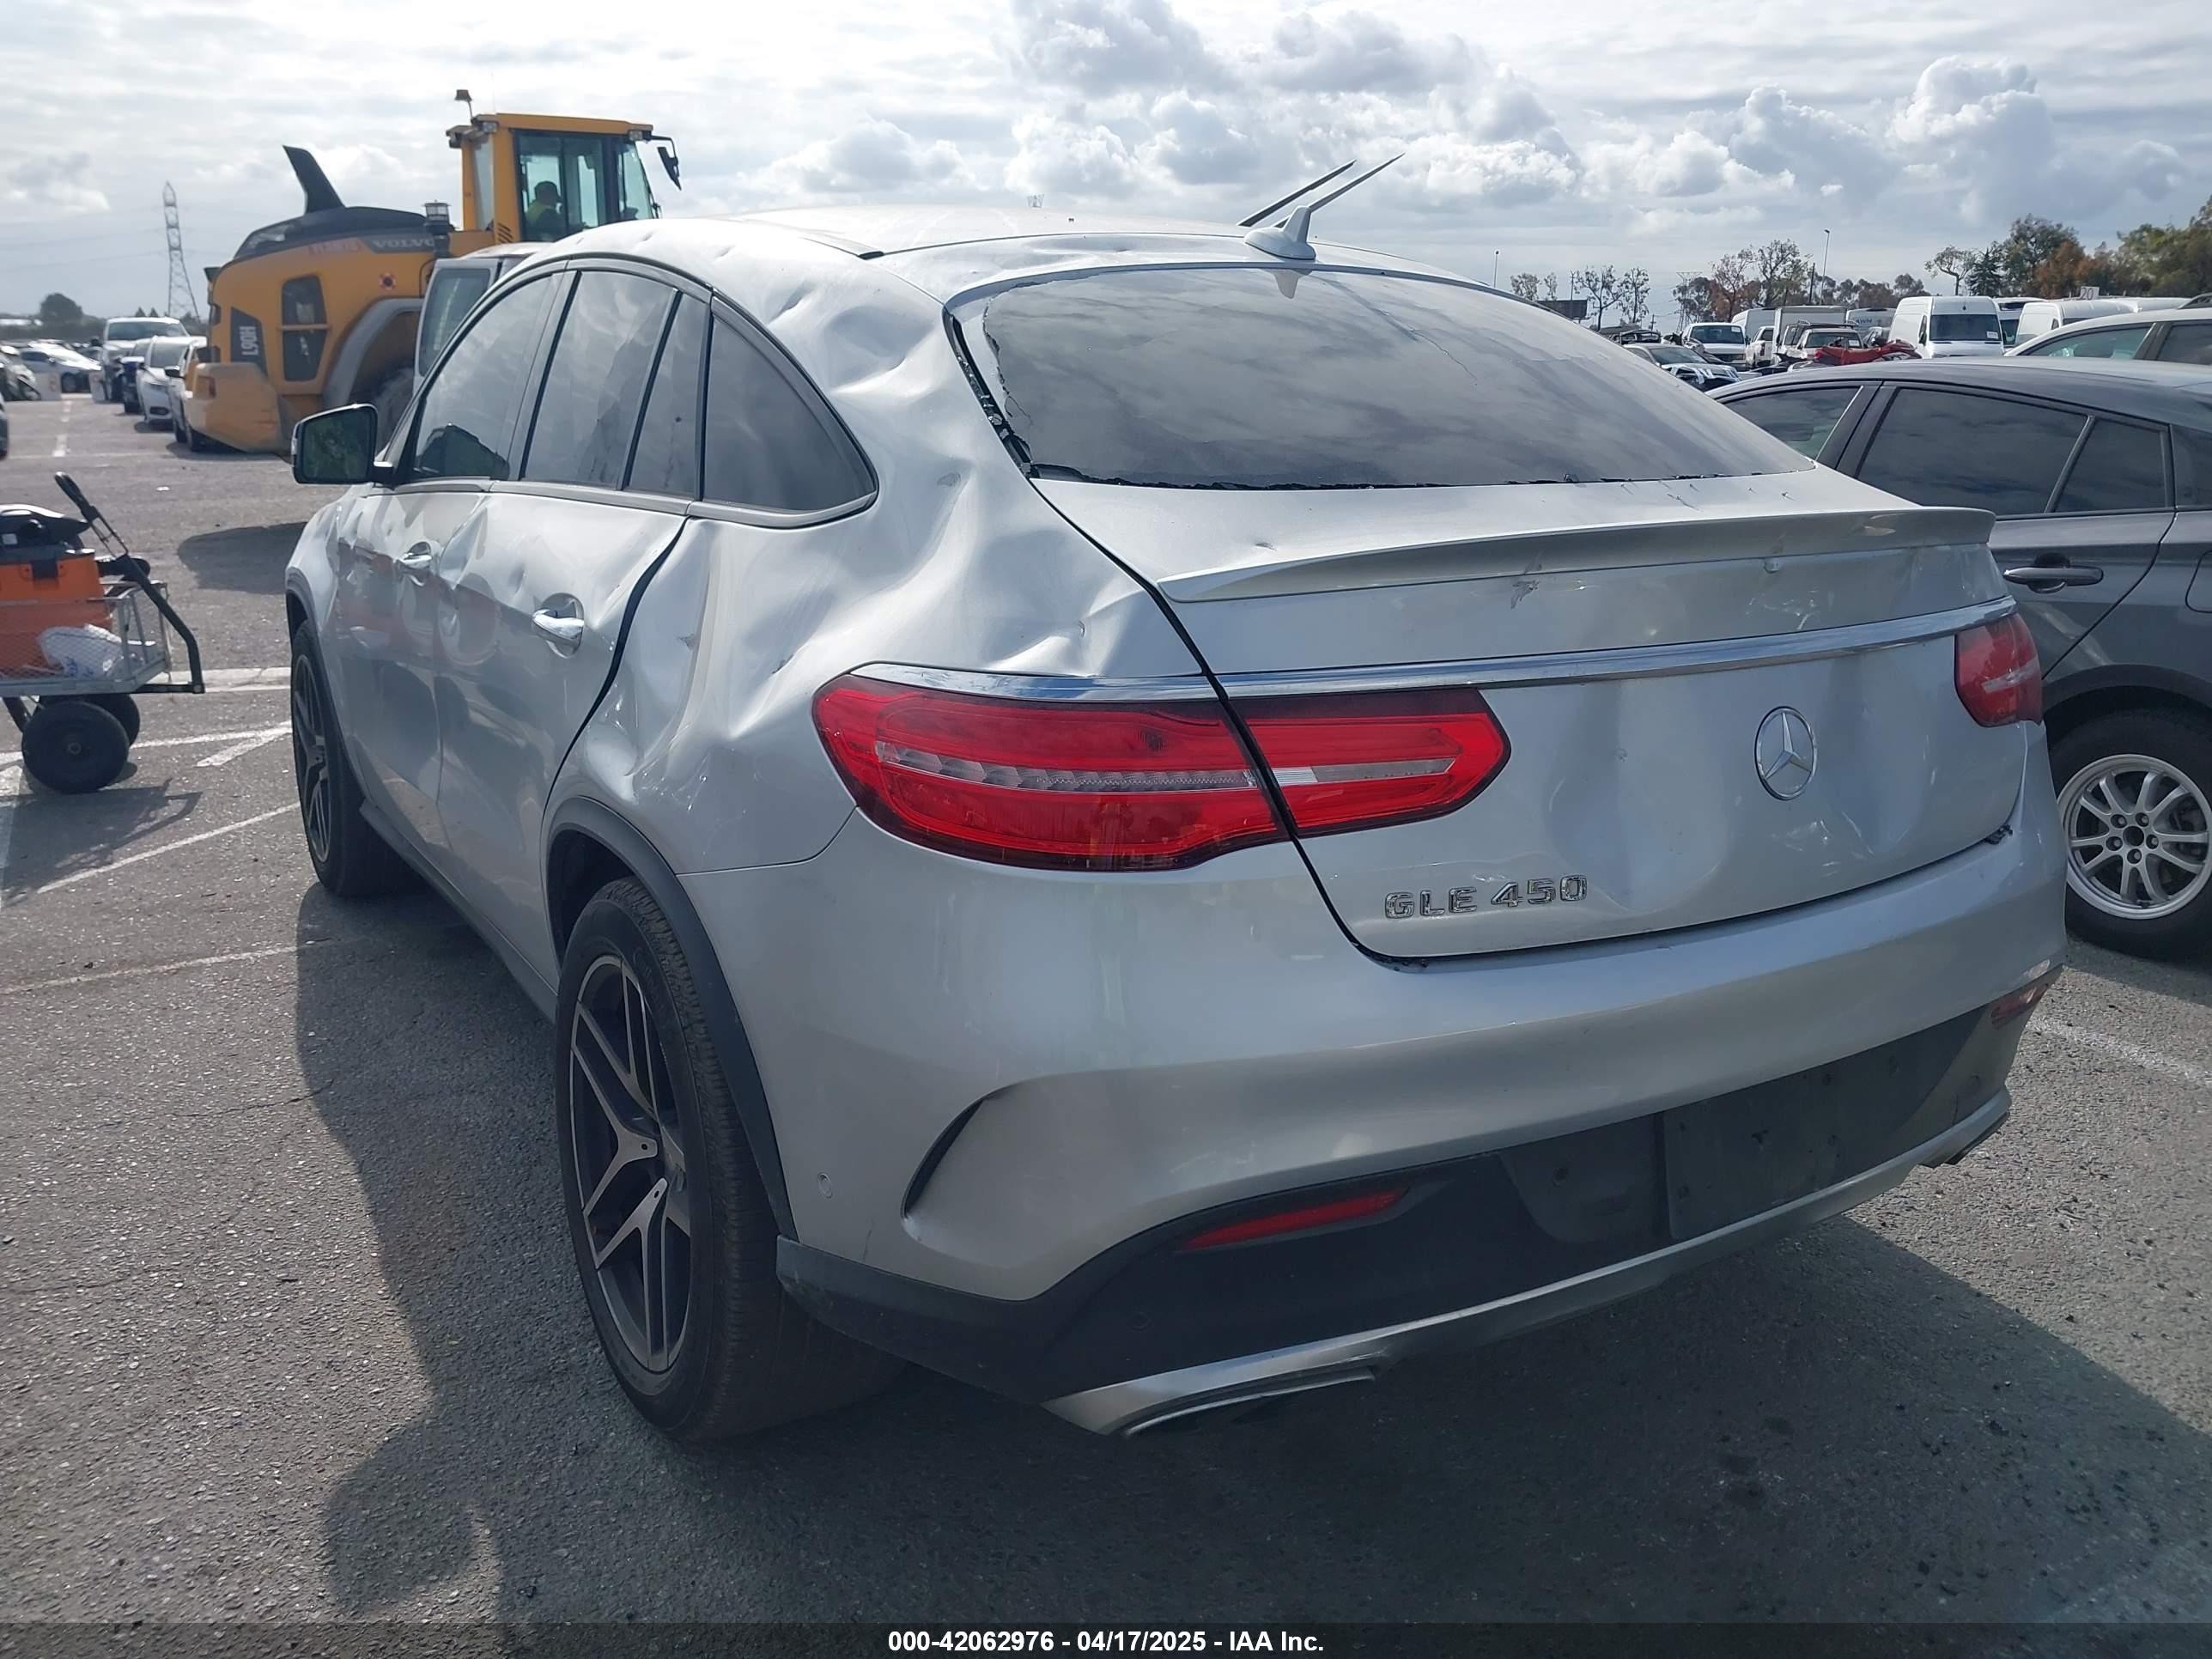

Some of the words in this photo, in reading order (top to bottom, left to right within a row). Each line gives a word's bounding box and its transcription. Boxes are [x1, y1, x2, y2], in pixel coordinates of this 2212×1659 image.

[2081, 288, 2094, 301] 20
[240, 326, 258, 356] L90H
[1385, 887, 1478, 919] GLE
[1491, 875, 1588, 907] 450
